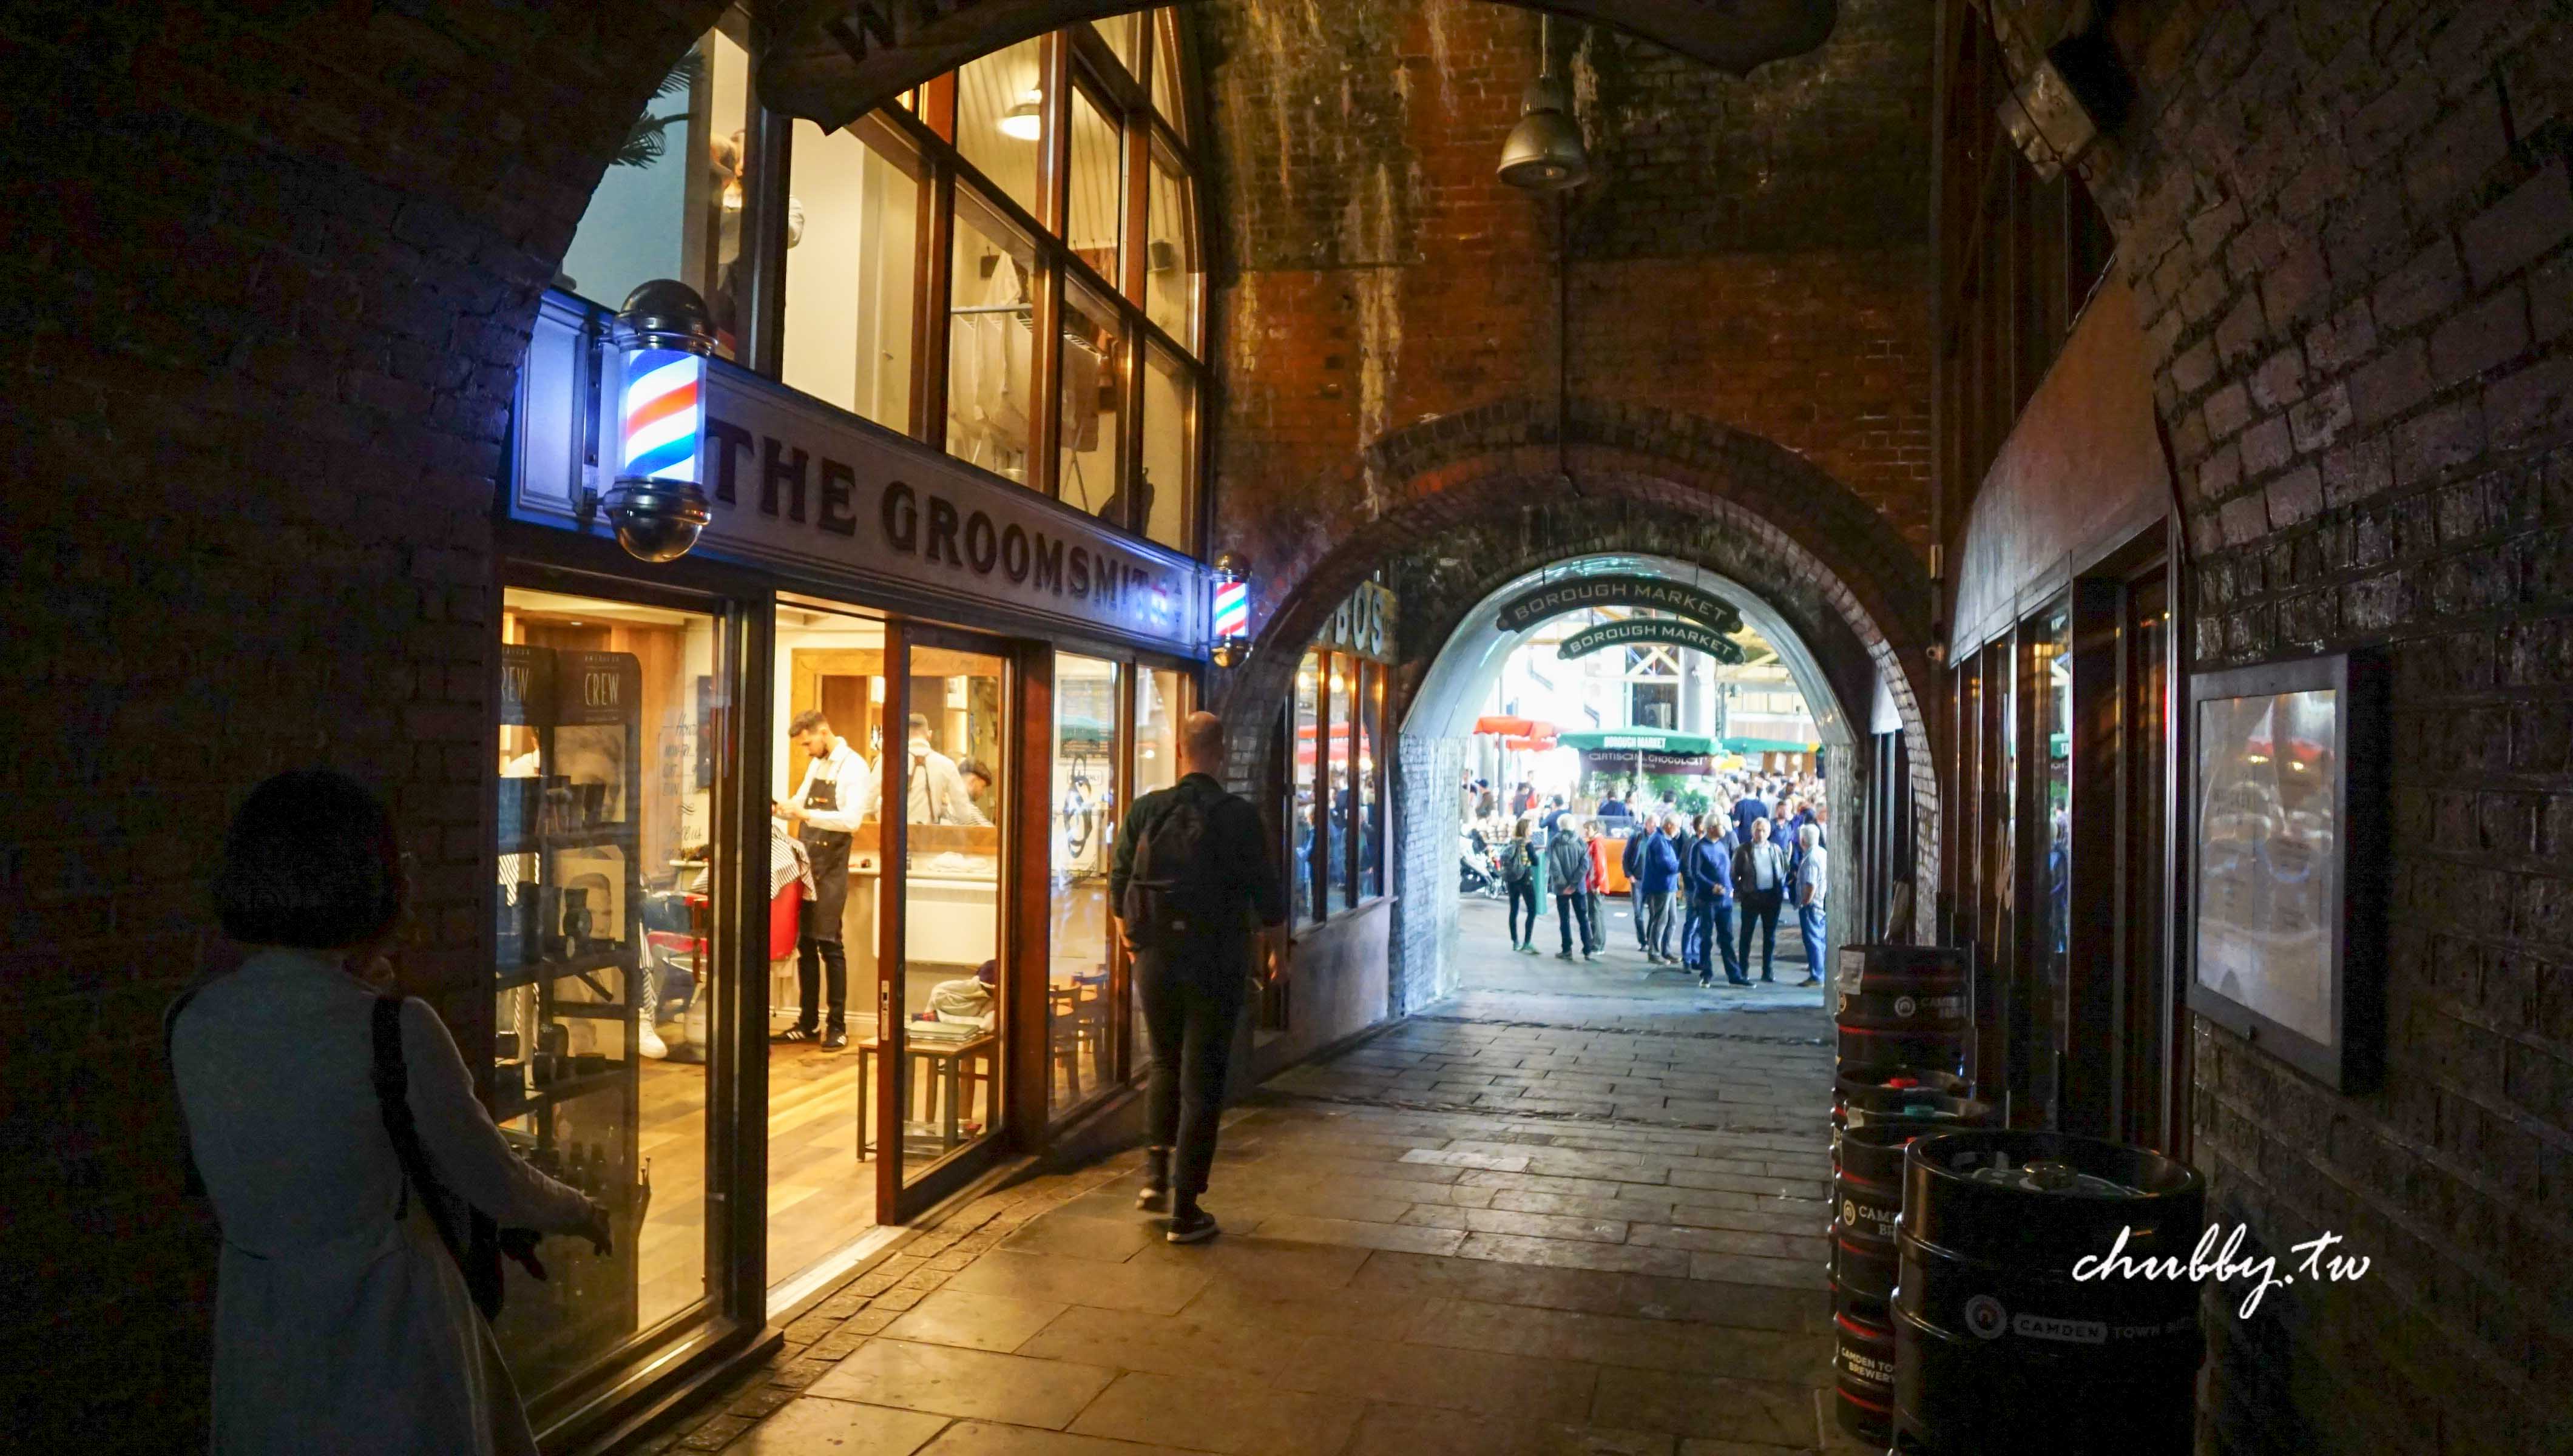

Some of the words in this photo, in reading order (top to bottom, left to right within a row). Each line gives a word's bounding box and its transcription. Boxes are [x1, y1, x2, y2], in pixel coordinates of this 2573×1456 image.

[706, 417, 857, 538] THE
[1513, 583, 1626, 621] BOROUGH
[1634, 584, 1727, 622] MARKET
[1317, 584, 1384, 656] BOS
[1569, 625, 1657, 654] BOROUGH
[1661, 625, 1733, 655] MARKET
[501, 666, 530, 703] REW
[584, 672, 620, 706] CREW
[1603, 736, 1637, 748] BOROUGH
[1637, 736, 1666, 749] MARKET
[2019, 1318, 2099, 1338] CAMDEN
[1841, 1346, 1876, 1370] CAMDEN
[1878, 1361, 1894, 1373] TO
